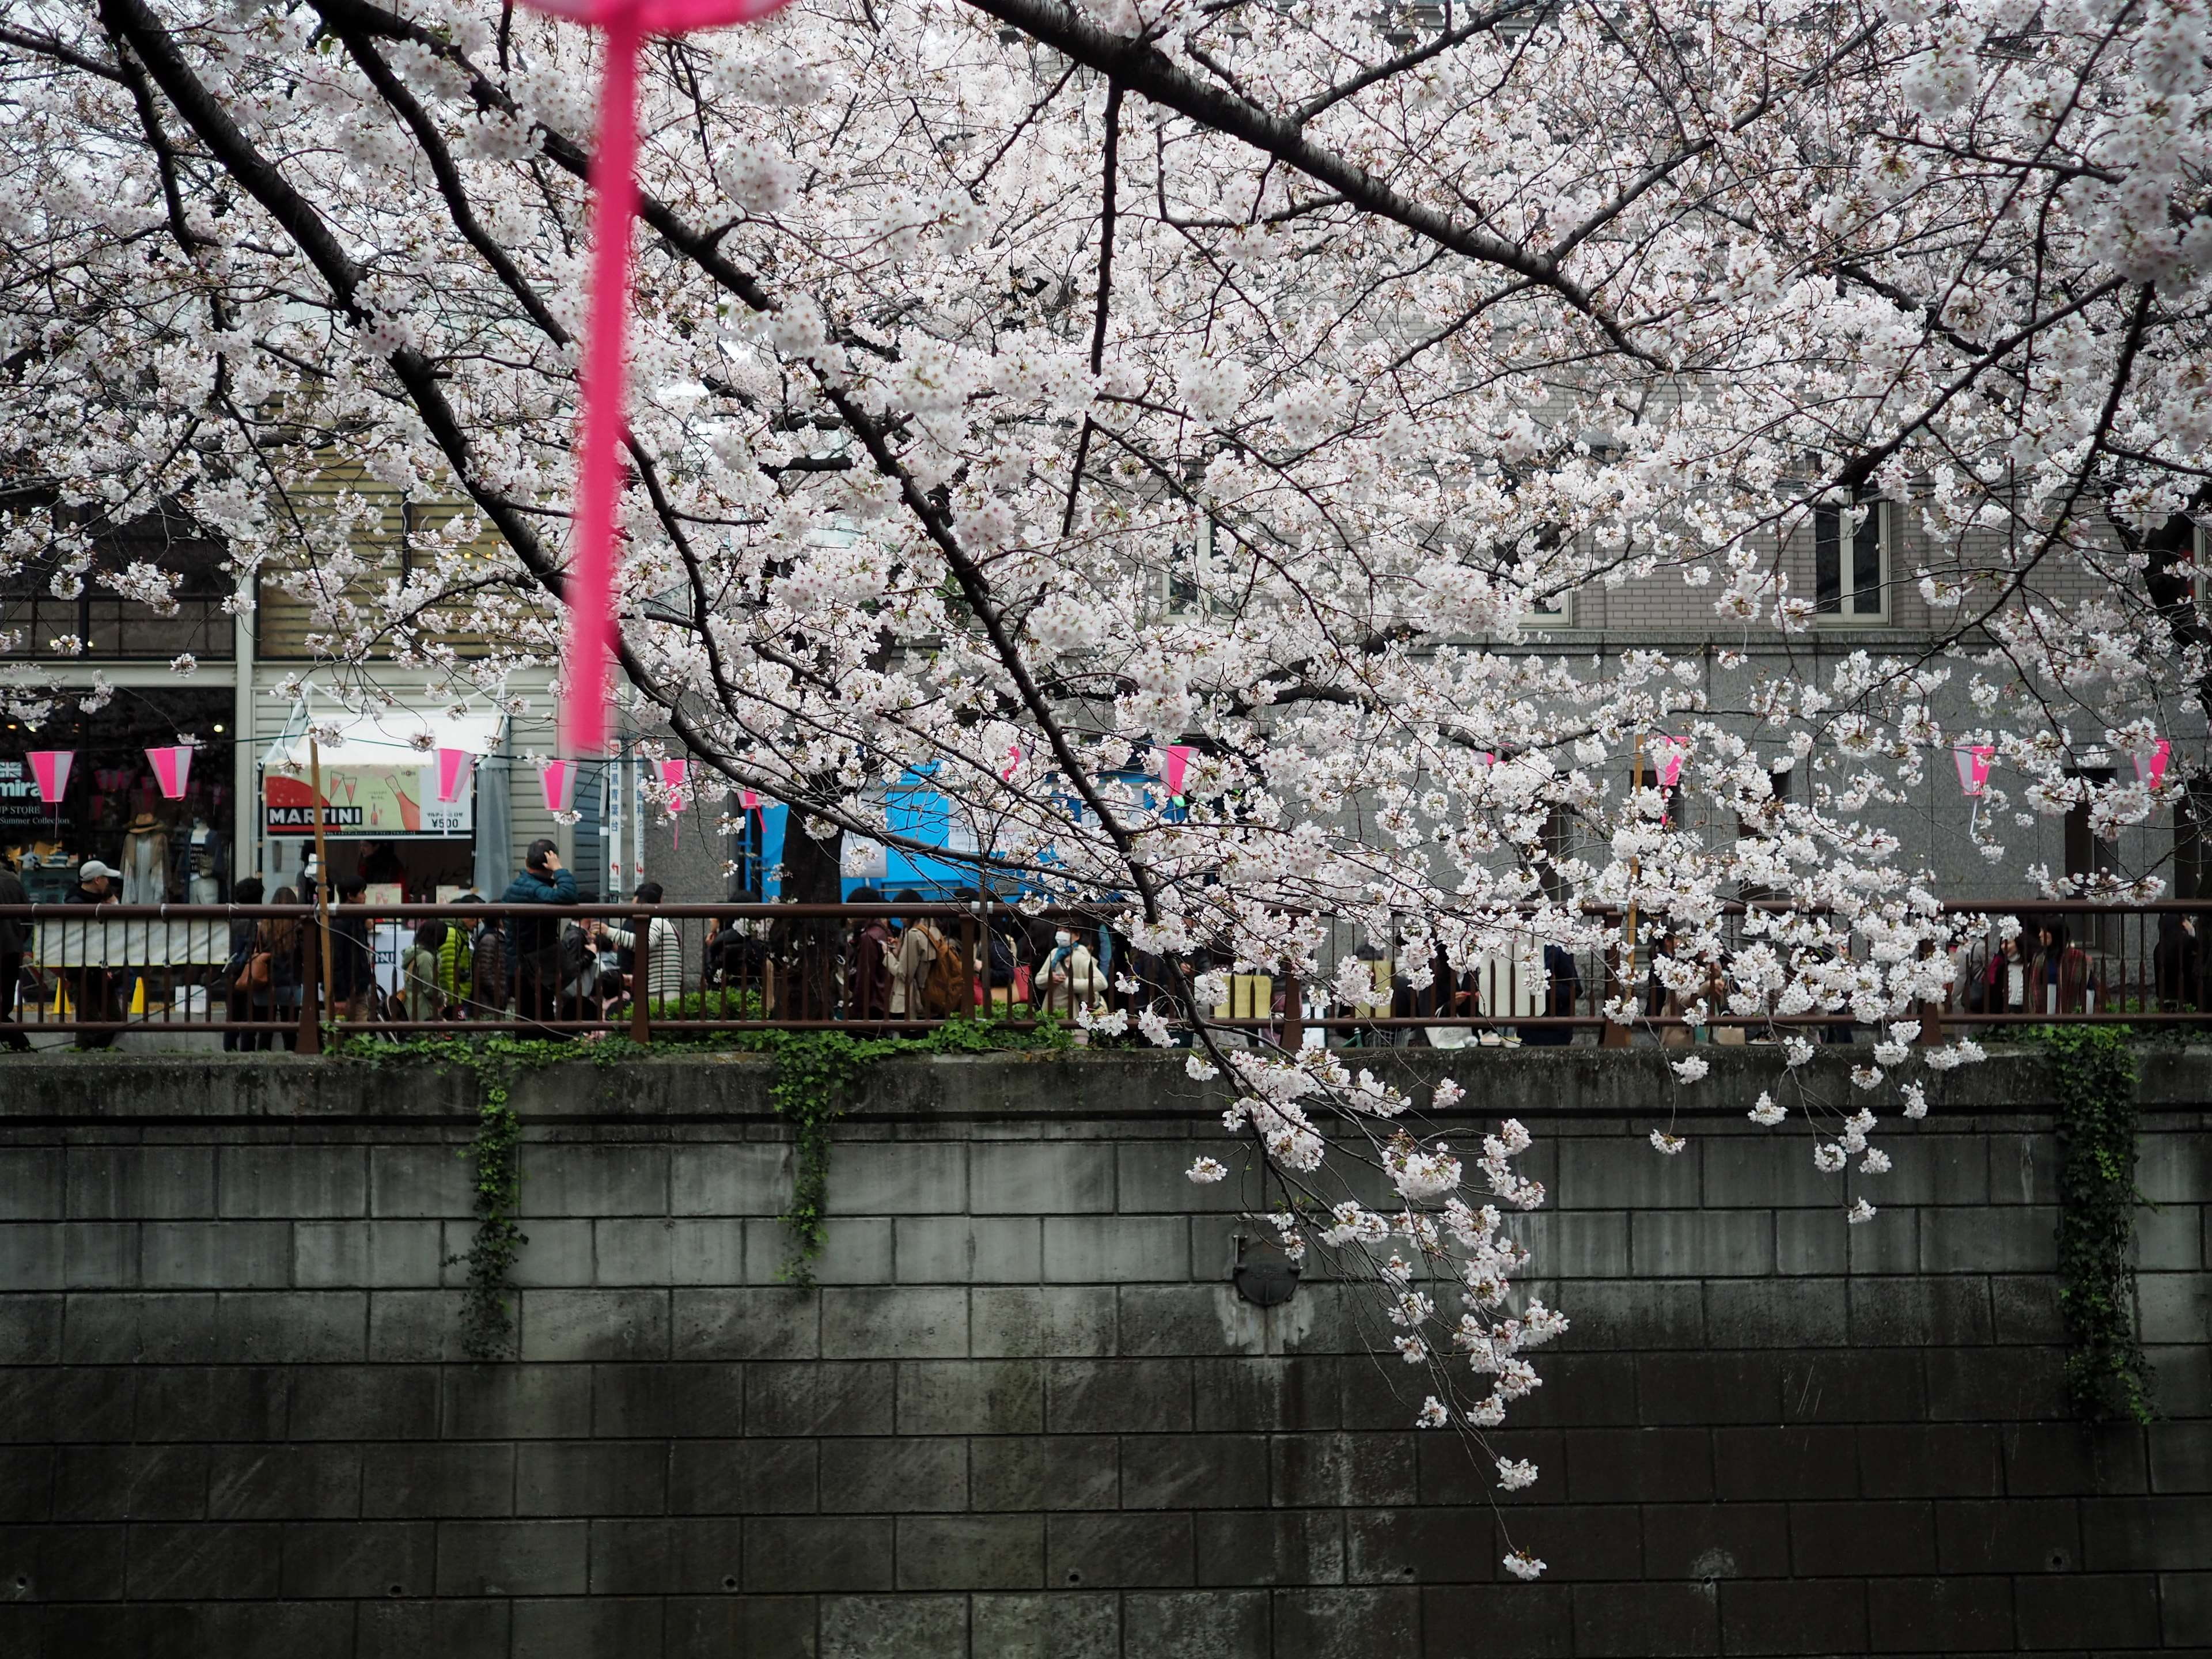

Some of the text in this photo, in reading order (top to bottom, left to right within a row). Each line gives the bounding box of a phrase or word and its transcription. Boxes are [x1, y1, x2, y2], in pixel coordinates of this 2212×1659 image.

[10, 806, 41, 815] STORE
[269, 808, 360, 824] MARTINI
[32, 817, 70, 825] Collecion
[431, 819, 459, 828] ¥500
